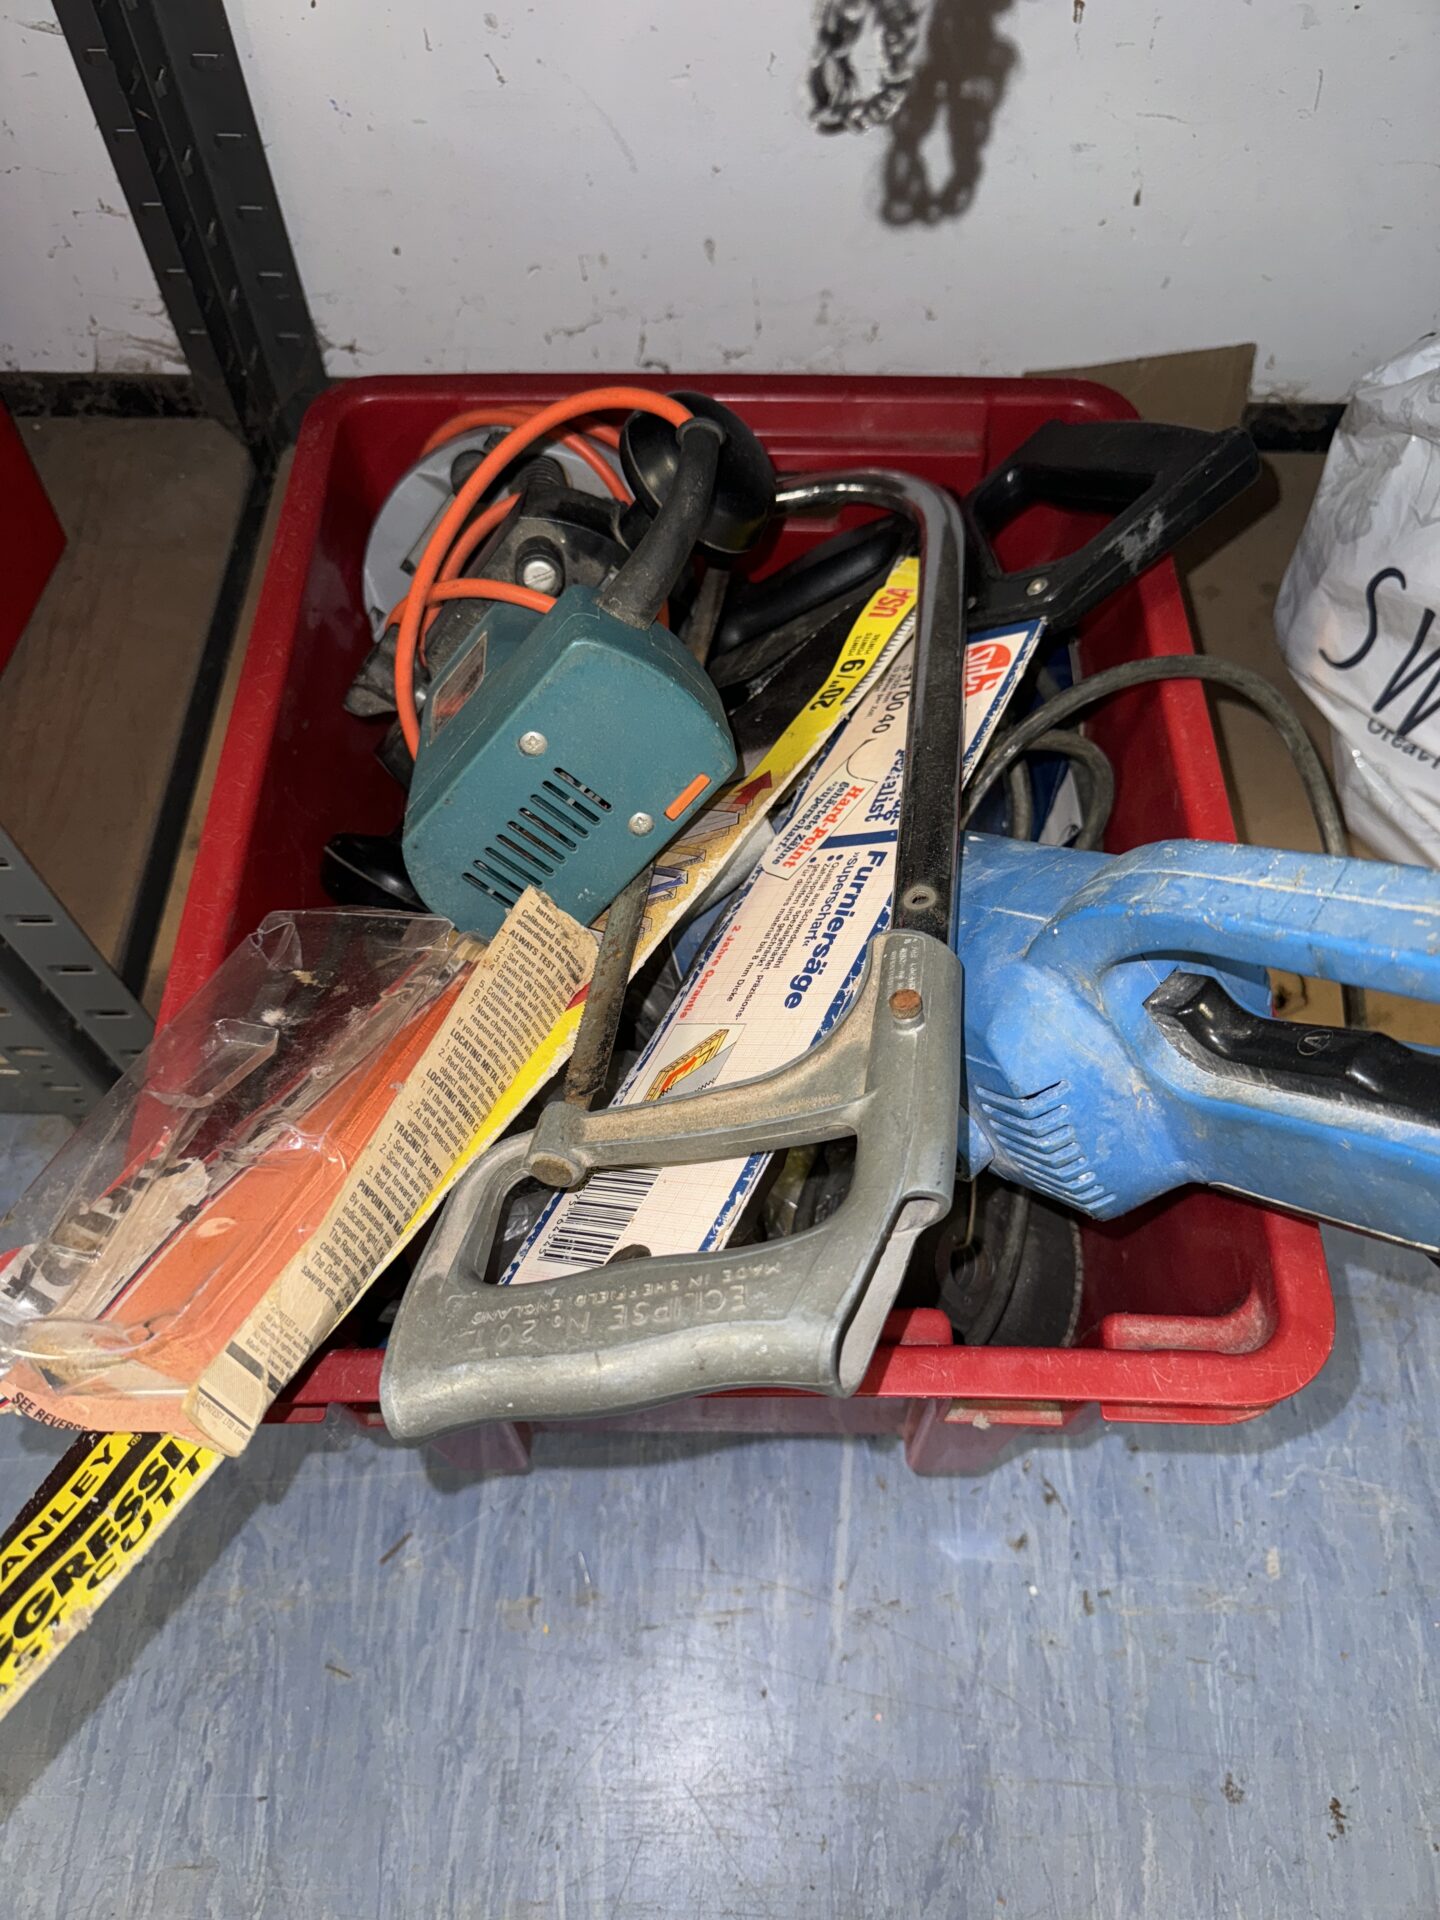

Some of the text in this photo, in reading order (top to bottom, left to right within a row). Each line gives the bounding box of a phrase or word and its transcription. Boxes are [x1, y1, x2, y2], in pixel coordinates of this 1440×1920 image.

[866, 586, 916, 618] USA
[781, 784, 866, 868] Hard-Point
[807, 893, 821, 906] aus
[515, 917, 565, 964] according to the
[520, 908, 555, 939] Calibrated
[554, 936, 562, 946] to
[730, 924, 742, 932] 2
[754, 941, 767, 952] bis
[772, 908, 813, 968] Schwedenstahl
[776, 849, 889, 1010] Furniersäge
[506, 951, 519, 966] Set
[508, 928, 538, 955] ALWAYS
[538, 952, 555, 972] TEST
[554, 968, 566, 985] THE
[511, 943, 536, 968] Remove
[535, 965, 544, 976] all
[542, 973, 558, 991] metal
[710, 935, 735, 965] Jahre
[740, 962, 754, 976] mm
[496, 968, 515, 989] Green
[514, 985, 528, 1003] light
[527, 998, 538, 1012] will
[501, 960, 524, 983] Switch
[522, 979, 533, 993] ON
[532, 988, 540, 1002] by
[725, 978, 745, 1001] Dicke
[474, 1003, 491, 1022] Now
[489, 1018, 508, 1039] check
[480, 994, 501, 1017] Rotate
[511, 1011, 518, 1021] to
[517, 1018, 531, 1038] rotate
[513, 1000, 533, 1023] always
[461, 1023, 475, 1038] you
[473, 1033, 488, 1051] have
[486, 1047, 508, 1077] difficulty
[469, 1013, 495, 1040] respond
[492, 1036, 508, 1056] when
[445, 1054, 459, 1071] Red
[456, 1066, 470, 1085] light
[468, 1081, 479, 1095] will
[449, 1027, 482, 1062] LOCATING
[480, 1058, 500, 1084] METAL
[450, 1044, 466, 1063] Hold
[464, 1059, 487, 1087] Detector
[425, 1067, 475, 1126] LOCATING POWER
[438, 1064, 471, 1103] object nears
[413, 1106, 423, 1120] As
[421, 1115, 433, 1131] the
[430, 1126, 452, 1154] Detector
[419, 1097, 438, 1119] signal
[435, 1113, 447, 1129] will
[444, 1125, 461, 1146] sound
[426, 1085, 433, 1095] If
[432, 1092, 443, 1107] the
[441, 1103, 457, 1123] metal
[454, 1118, 470, 1141] object
[392, 1119, 421, 1153] TRACING
[419, 1148, 433, 1166] THE
[392, 1138, 405, 1155] Set
[379, 1162, 392, 1180] way
[391, 1174, 413, 1201] forward
[385, 1149, 402, 1170] Scan
[399, 1165, 411, 1180] the
[408, 1176, 421, 1193] area
[356, 1178, 395, 1225] PINPOINTING
[373, 1171, 386, 1189] Red
[384, 1184, 405, 1213] detector
[333, 1214, 359, 1244] pinpoint
[341, 1202, 367, 1234] indicator
[348, 1190, 386, 1236] By repeatedly
[319, 1240, 343, 1268] ceilings
[327, 1226, 342, 1245] The
[301, 1263, 326, 1292] sawing
[310, 1250, 326, 1269] The
[606, 1282, 746, 1331] ECLIPSE
[11, 1389, 34, 1414] SEE
